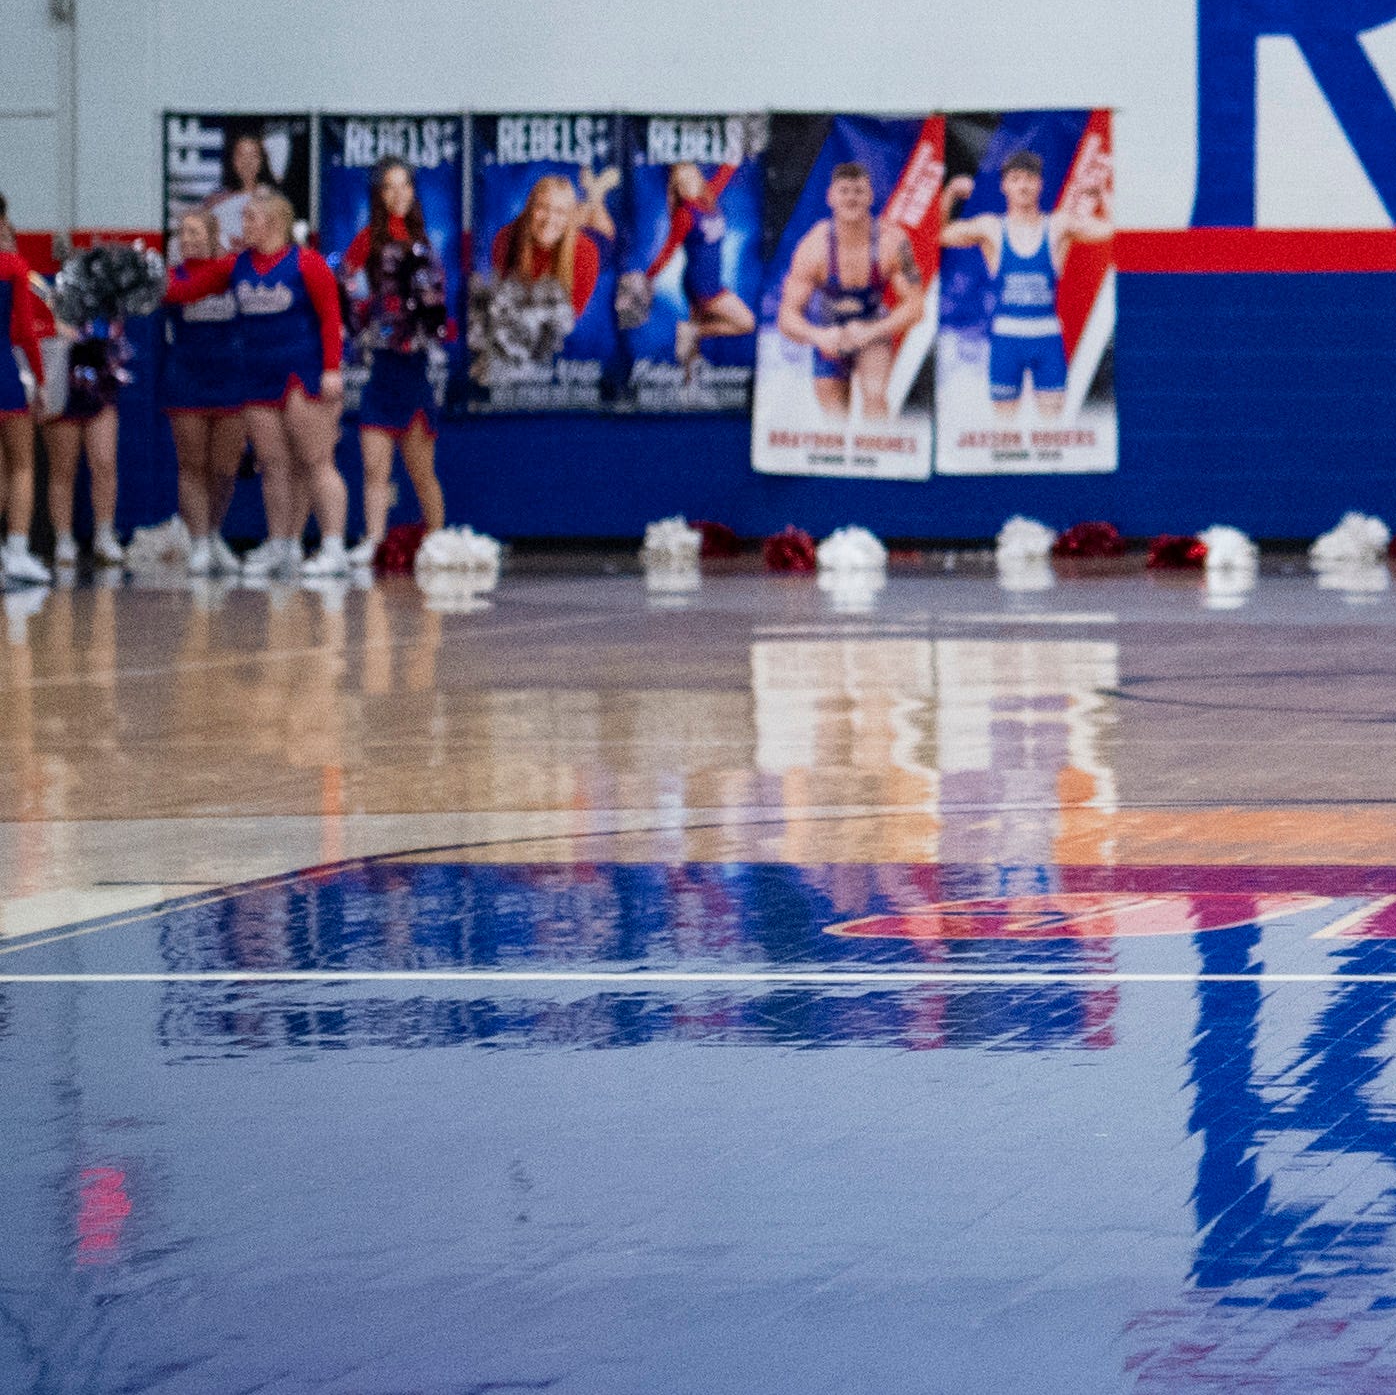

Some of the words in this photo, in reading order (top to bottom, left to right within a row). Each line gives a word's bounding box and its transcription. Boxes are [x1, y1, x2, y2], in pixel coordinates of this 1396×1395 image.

[344, 117, 441, 170] REBELS
[496, 115, 594, 164] REBELS
[648, 116, 743, 166] REBELS
